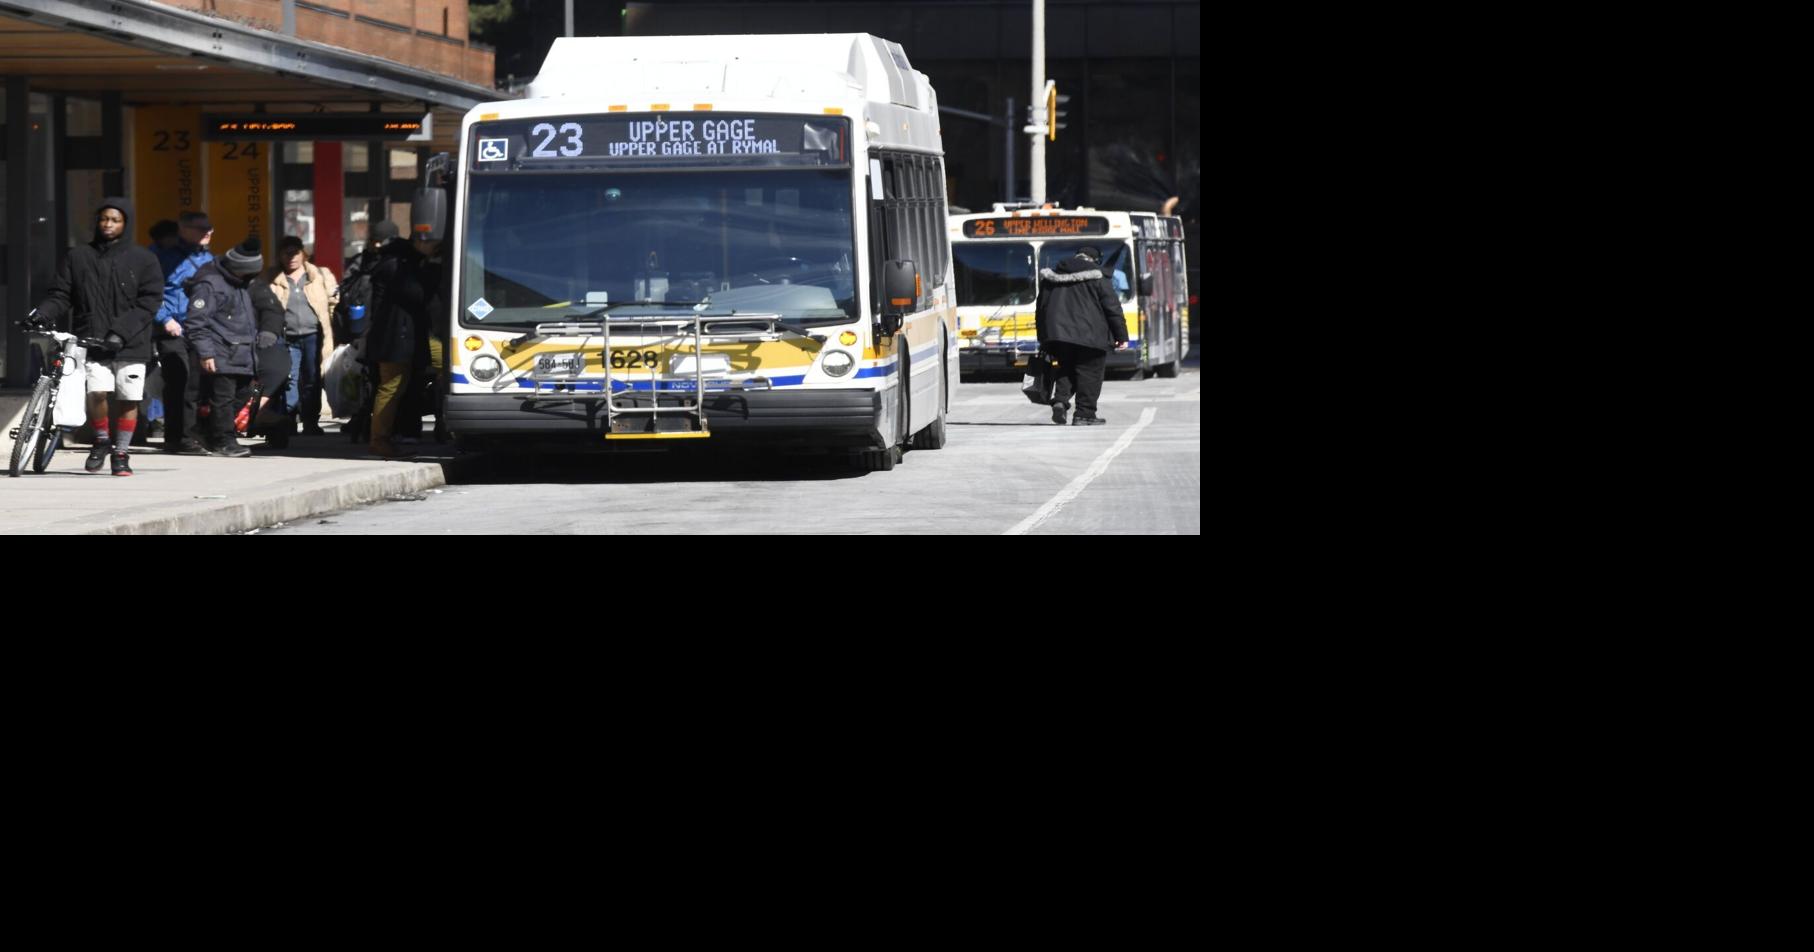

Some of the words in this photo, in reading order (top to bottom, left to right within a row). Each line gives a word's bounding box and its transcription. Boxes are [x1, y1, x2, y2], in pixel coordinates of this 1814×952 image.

[152, 130, 191, 152] 23
[531, 122, 584, 158] 23
[629, 120, 695, 142] UPPER
[702, 119, 756, 141] GAGE
[222, 141, 260, 161] 24
[609, 141, 657, 156] UPPER
[661, 140, 702, 155] GAGE
[707, 139, 728, 154] AT
[732, 139, 781, 154] RYMAL
[178, 159, 192, 207] UPPER
[247, 167, 261, 212] UPPER
[975, 220, 995, 236] 26
[597, 350, 658, 369] 1628
